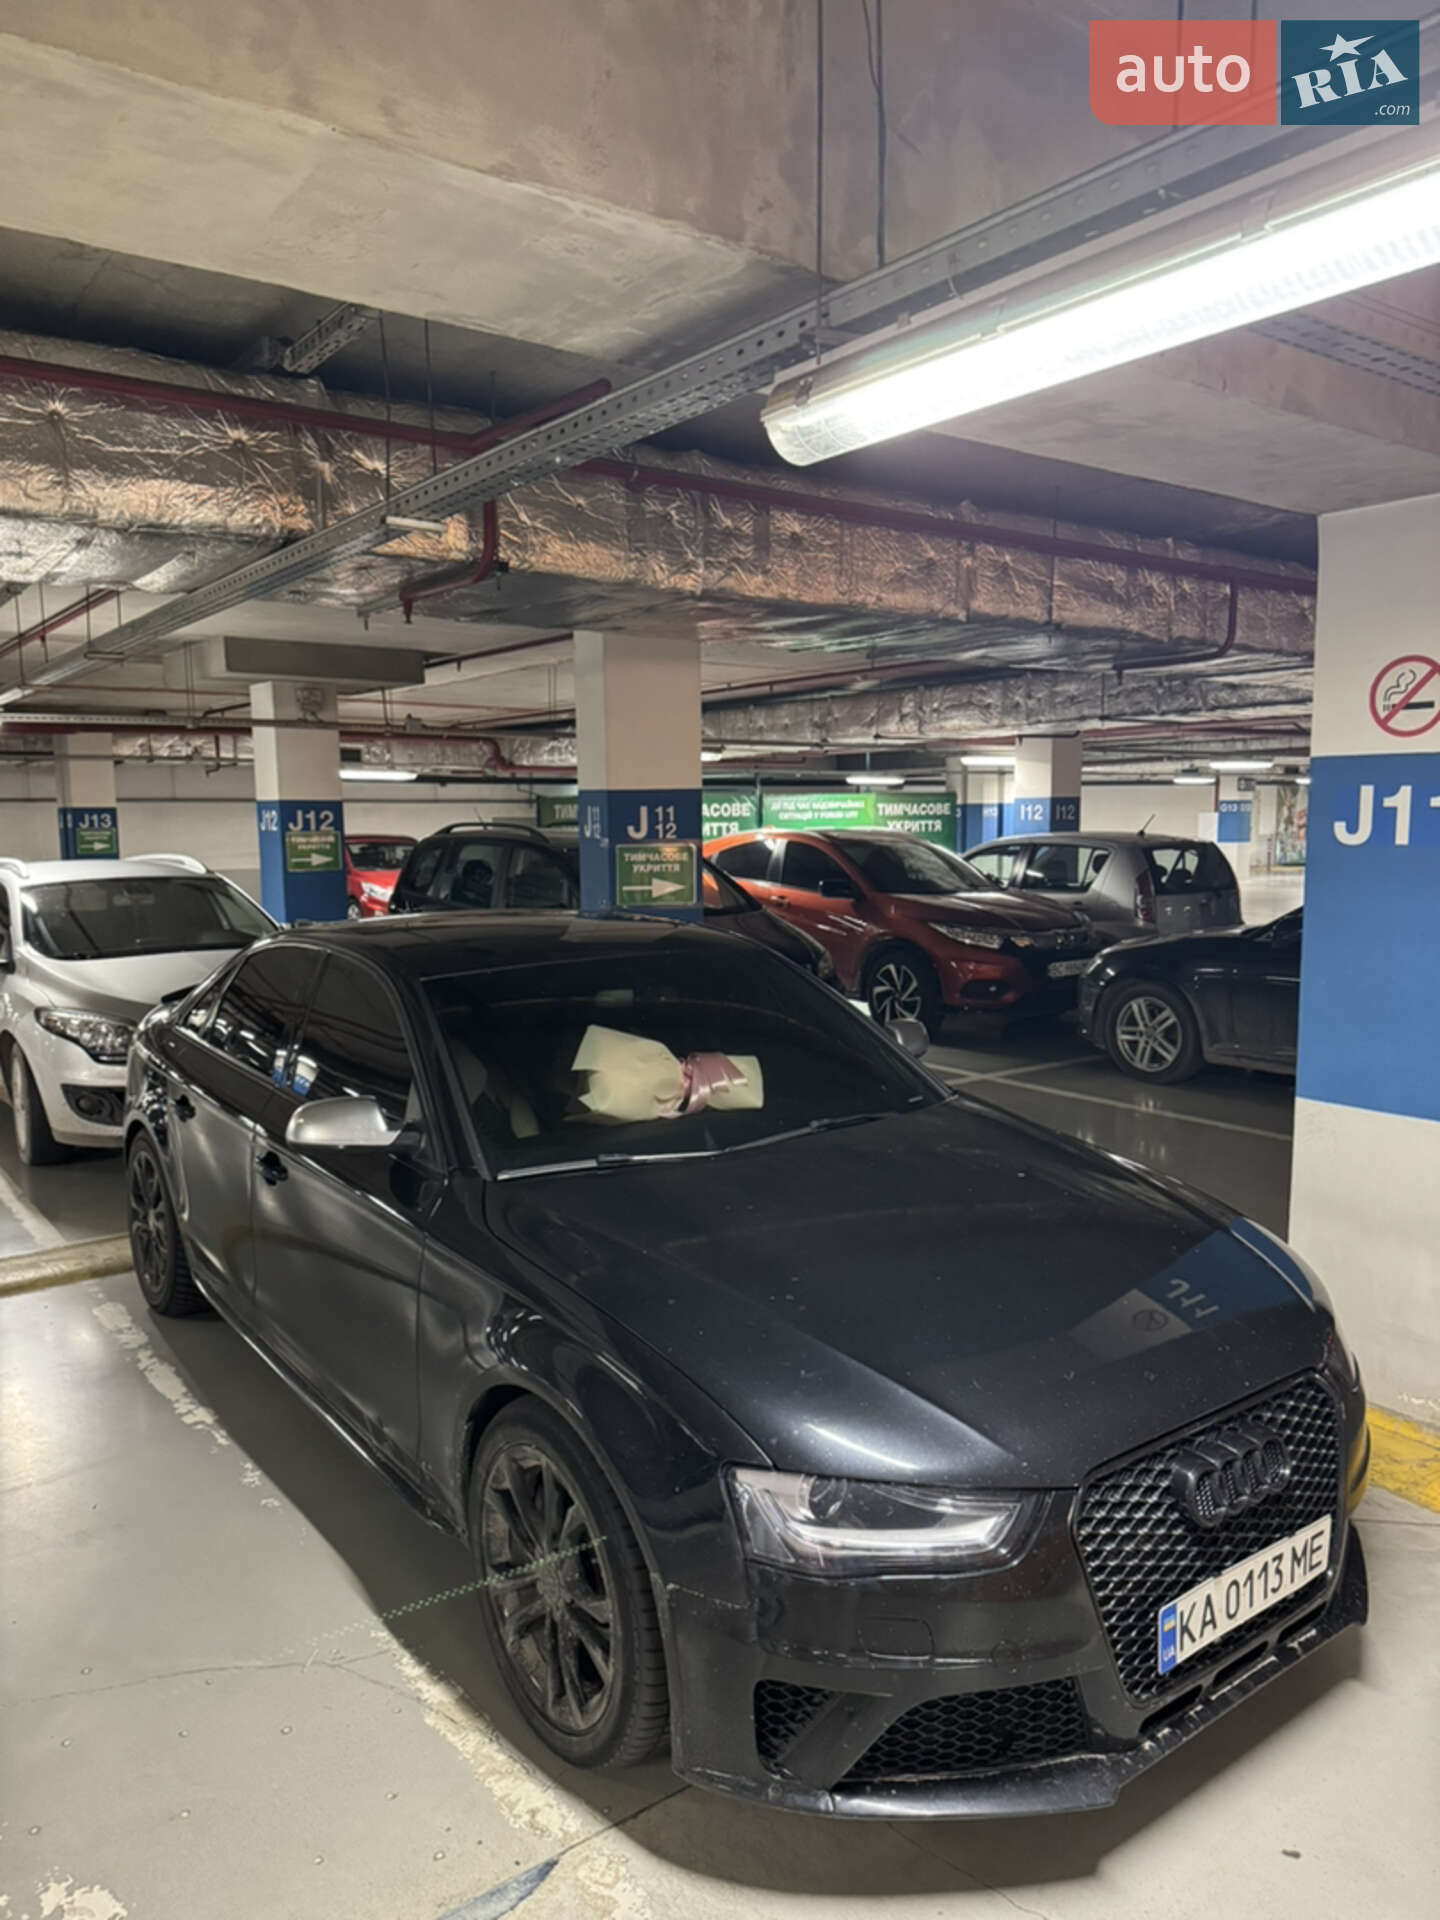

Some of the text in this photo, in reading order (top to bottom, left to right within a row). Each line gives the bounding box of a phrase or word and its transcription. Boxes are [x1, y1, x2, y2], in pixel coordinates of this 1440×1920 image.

[655, 806, 676, 822] 11
[702, 803, 750, 817] АСОВЕ
[877, 803, 951, 816] ТИМЧАСОВЕ
[79, 813, 112, 828] J13
[260, 809, 278, 832] J12
[288, 809, 335, 832] J12
[627, 806, 649, 839] J
[655, 823, 677, 838] 12
[702, 822, 739, 837] ИТТЯ
[624, 852, 688, 862] ТИМЧАСОВЕ
[632, 863, 680, 873] УКРИТТЯ
[1179, 1529, 1325, 1651] KA 0113 ME
